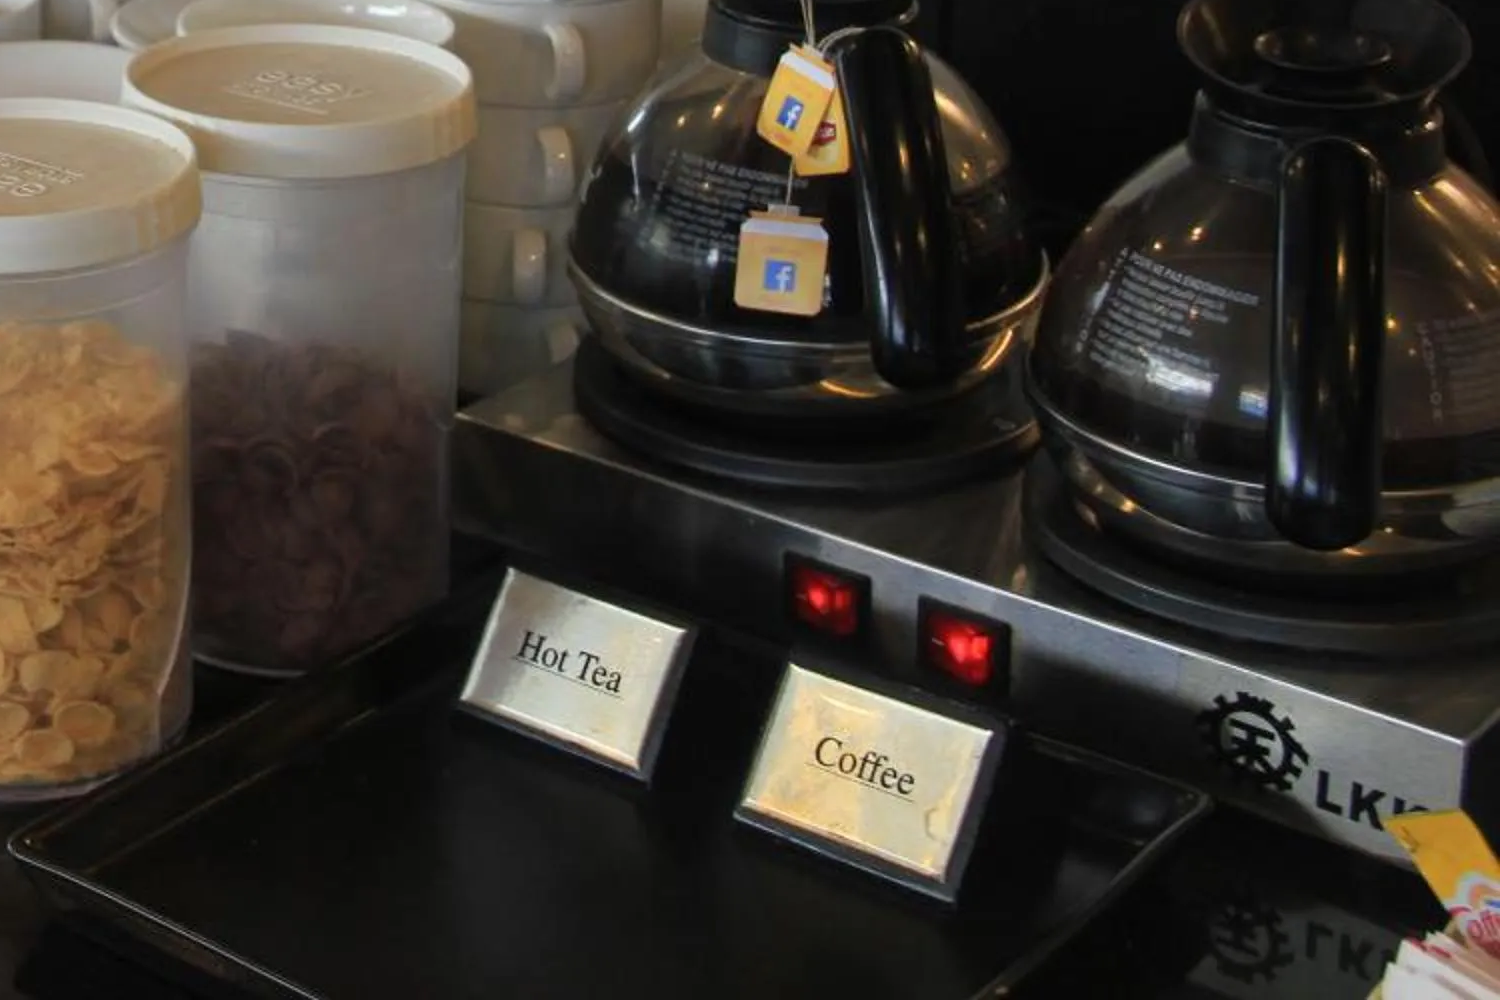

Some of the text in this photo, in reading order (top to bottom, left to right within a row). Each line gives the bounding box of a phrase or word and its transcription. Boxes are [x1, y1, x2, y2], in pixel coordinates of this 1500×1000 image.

[516, 630, 623, 695] Hot Tea
[814, 736, 916, 796] Coffee
[1315, 768, 1431, 832] LK
